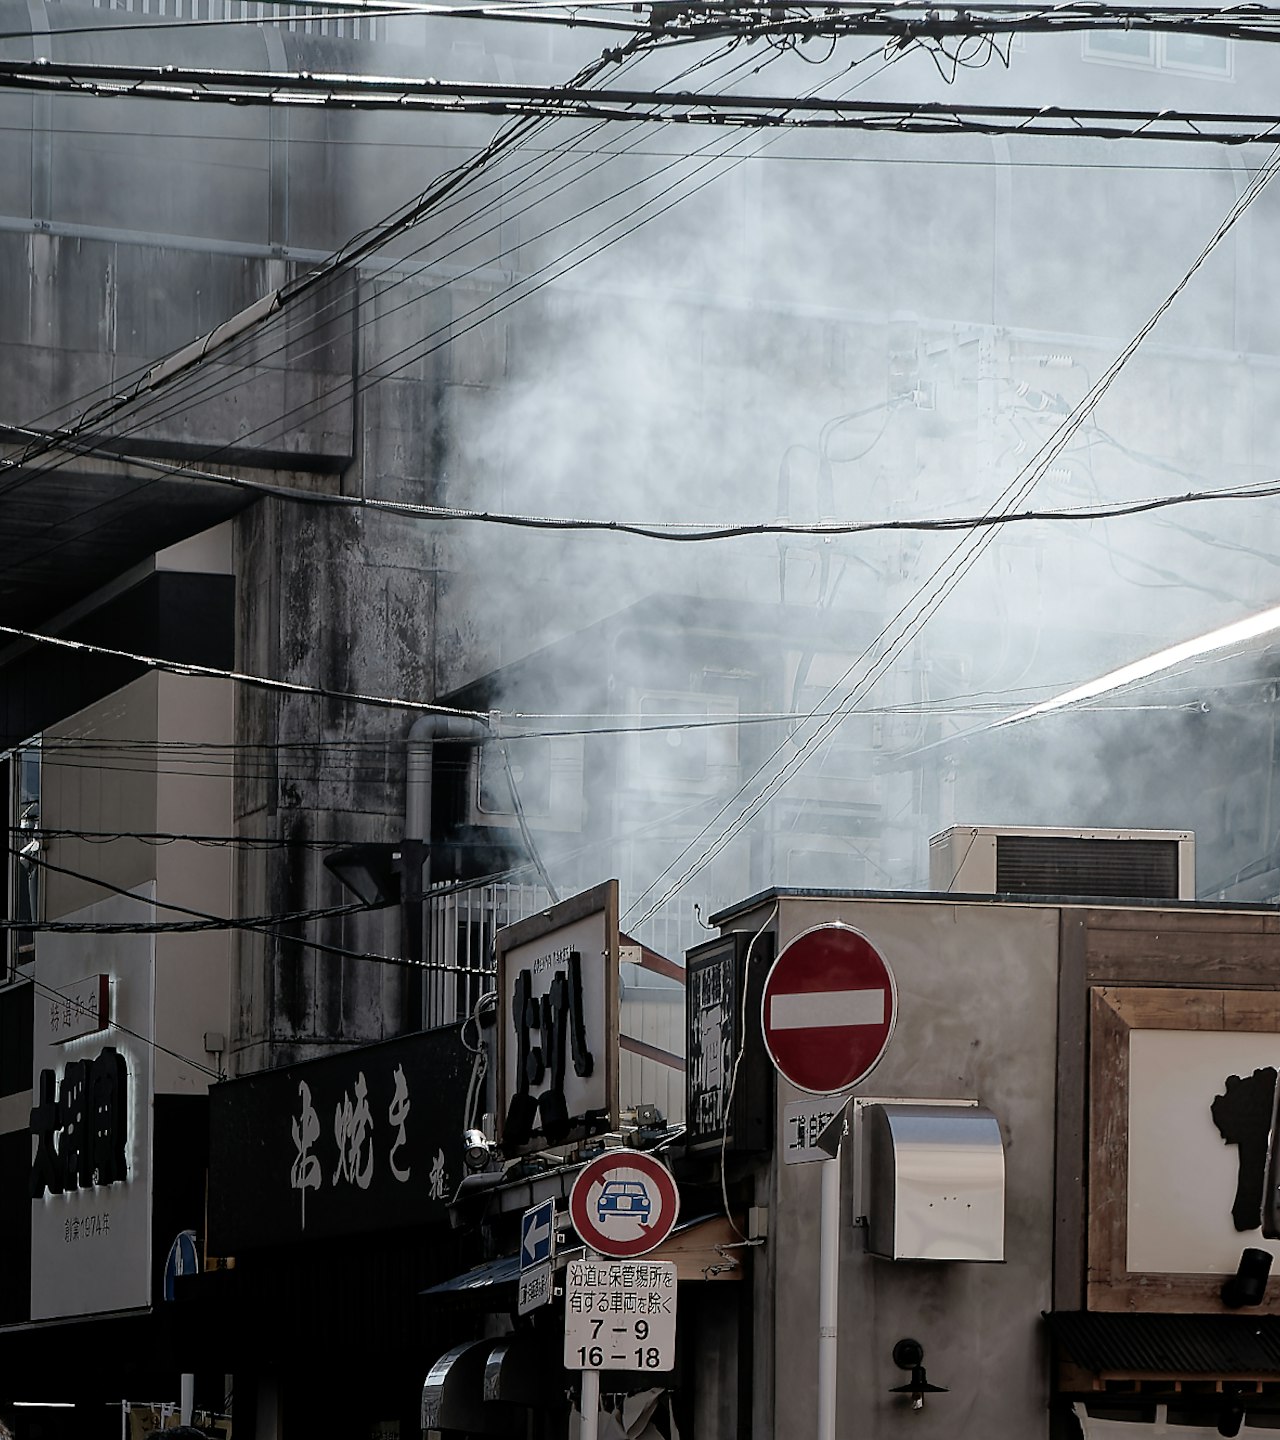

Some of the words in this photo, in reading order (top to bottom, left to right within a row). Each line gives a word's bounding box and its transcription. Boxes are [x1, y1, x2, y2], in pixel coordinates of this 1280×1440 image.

[290, 1061, 412, 1232] 串焼き
[570, 1264, 673, 1289] 沿道に保管場所を
[569, 1290, 672, 1315] 有する車両を除く
